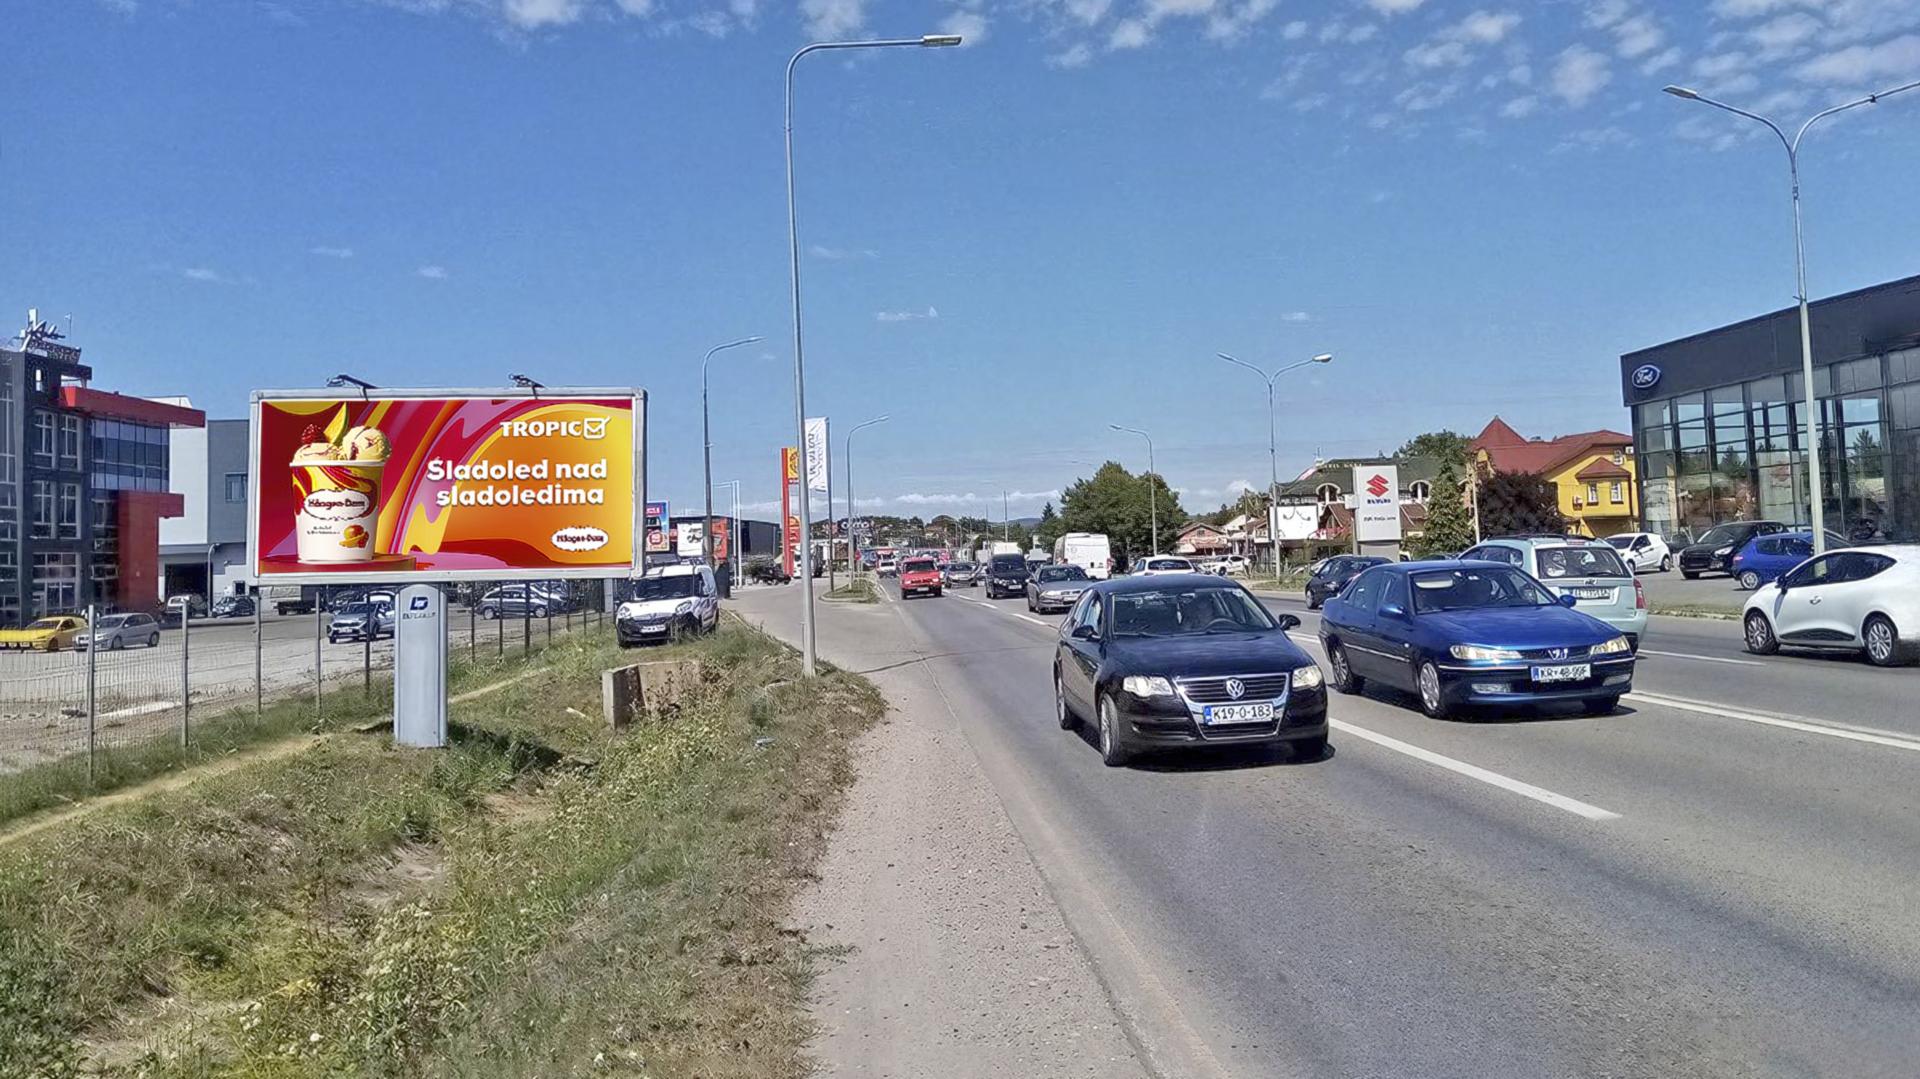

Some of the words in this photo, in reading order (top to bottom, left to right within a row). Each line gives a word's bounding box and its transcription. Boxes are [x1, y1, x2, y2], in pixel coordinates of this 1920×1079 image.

[500, 421, 582, 438] TROPIC
[426, 458, 549, 481] Sladoled
[555, 458, 607, 480] nad
[436, 484, 604, 506] sladoledima
